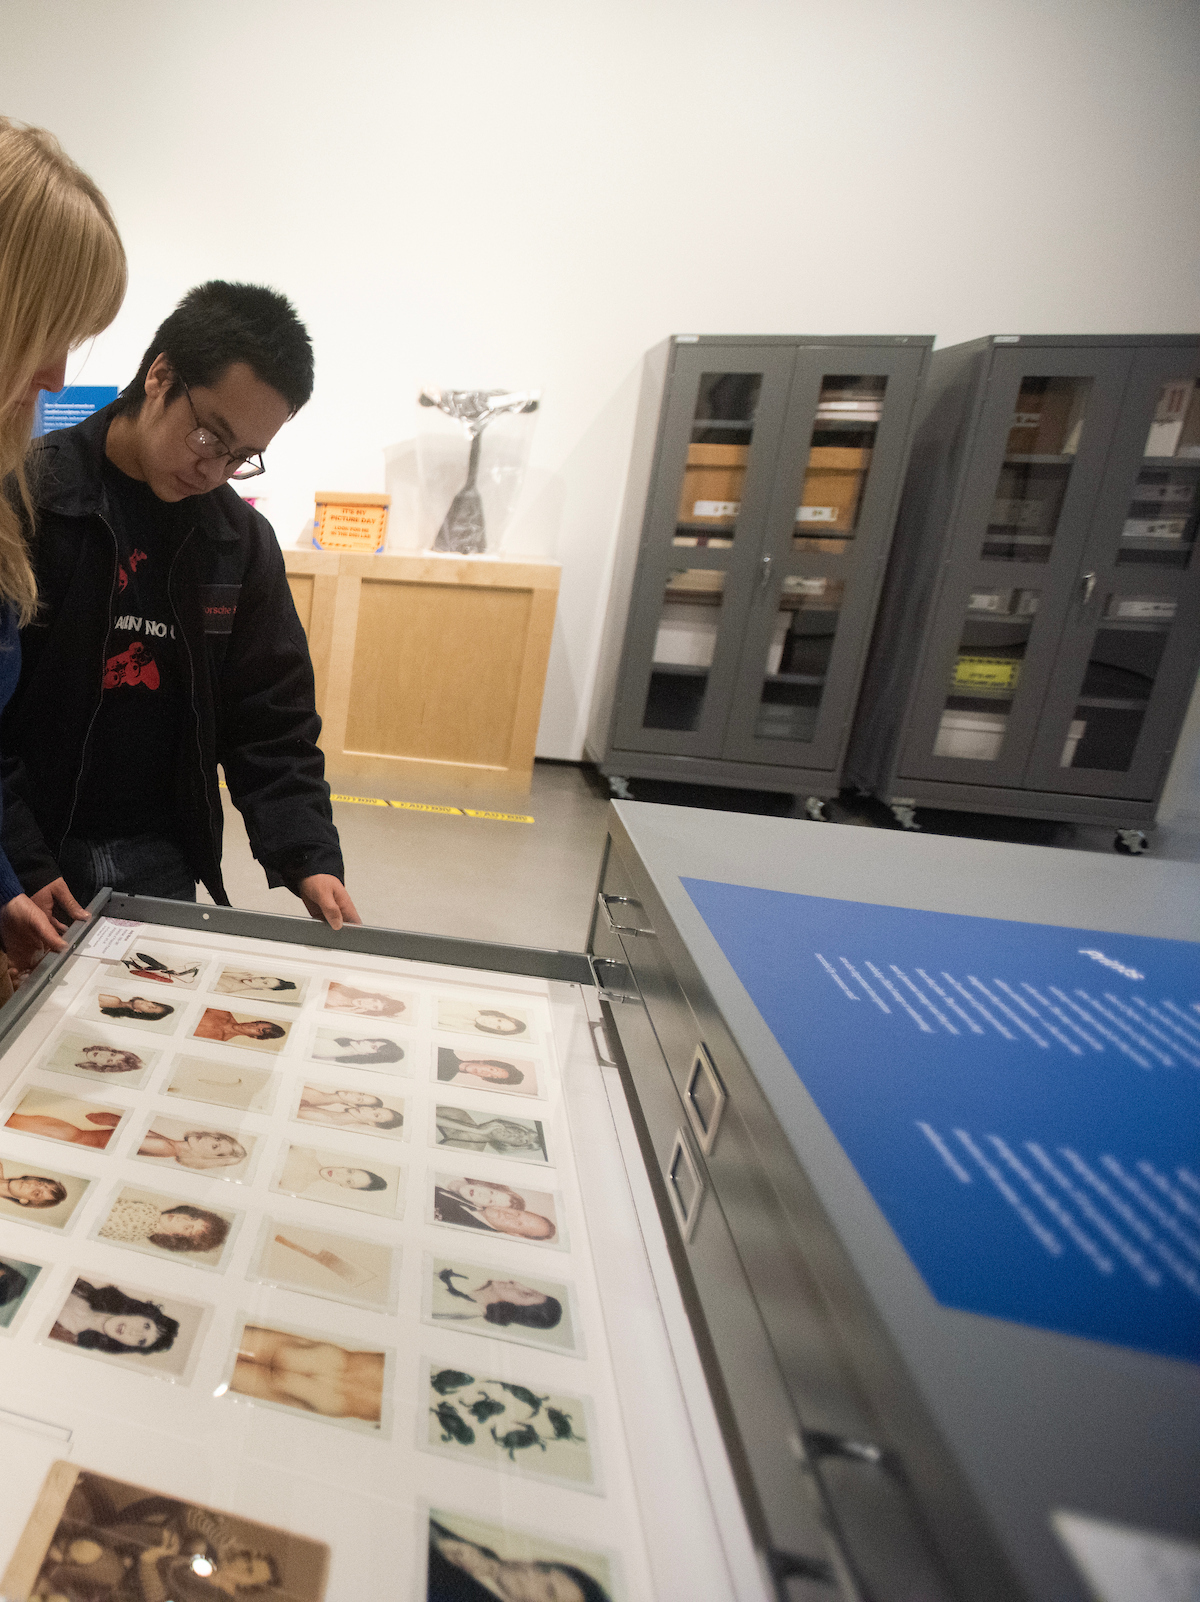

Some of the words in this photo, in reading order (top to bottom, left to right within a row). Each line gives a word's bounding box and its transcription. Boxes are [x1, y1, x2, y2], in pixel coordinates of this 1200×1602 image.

[205, 605, 231, 614] orsche
[114, 615, 143, 632] AIN
[145, 620, 167, 638] NO
[336, 795, 377, 804] AUTION
